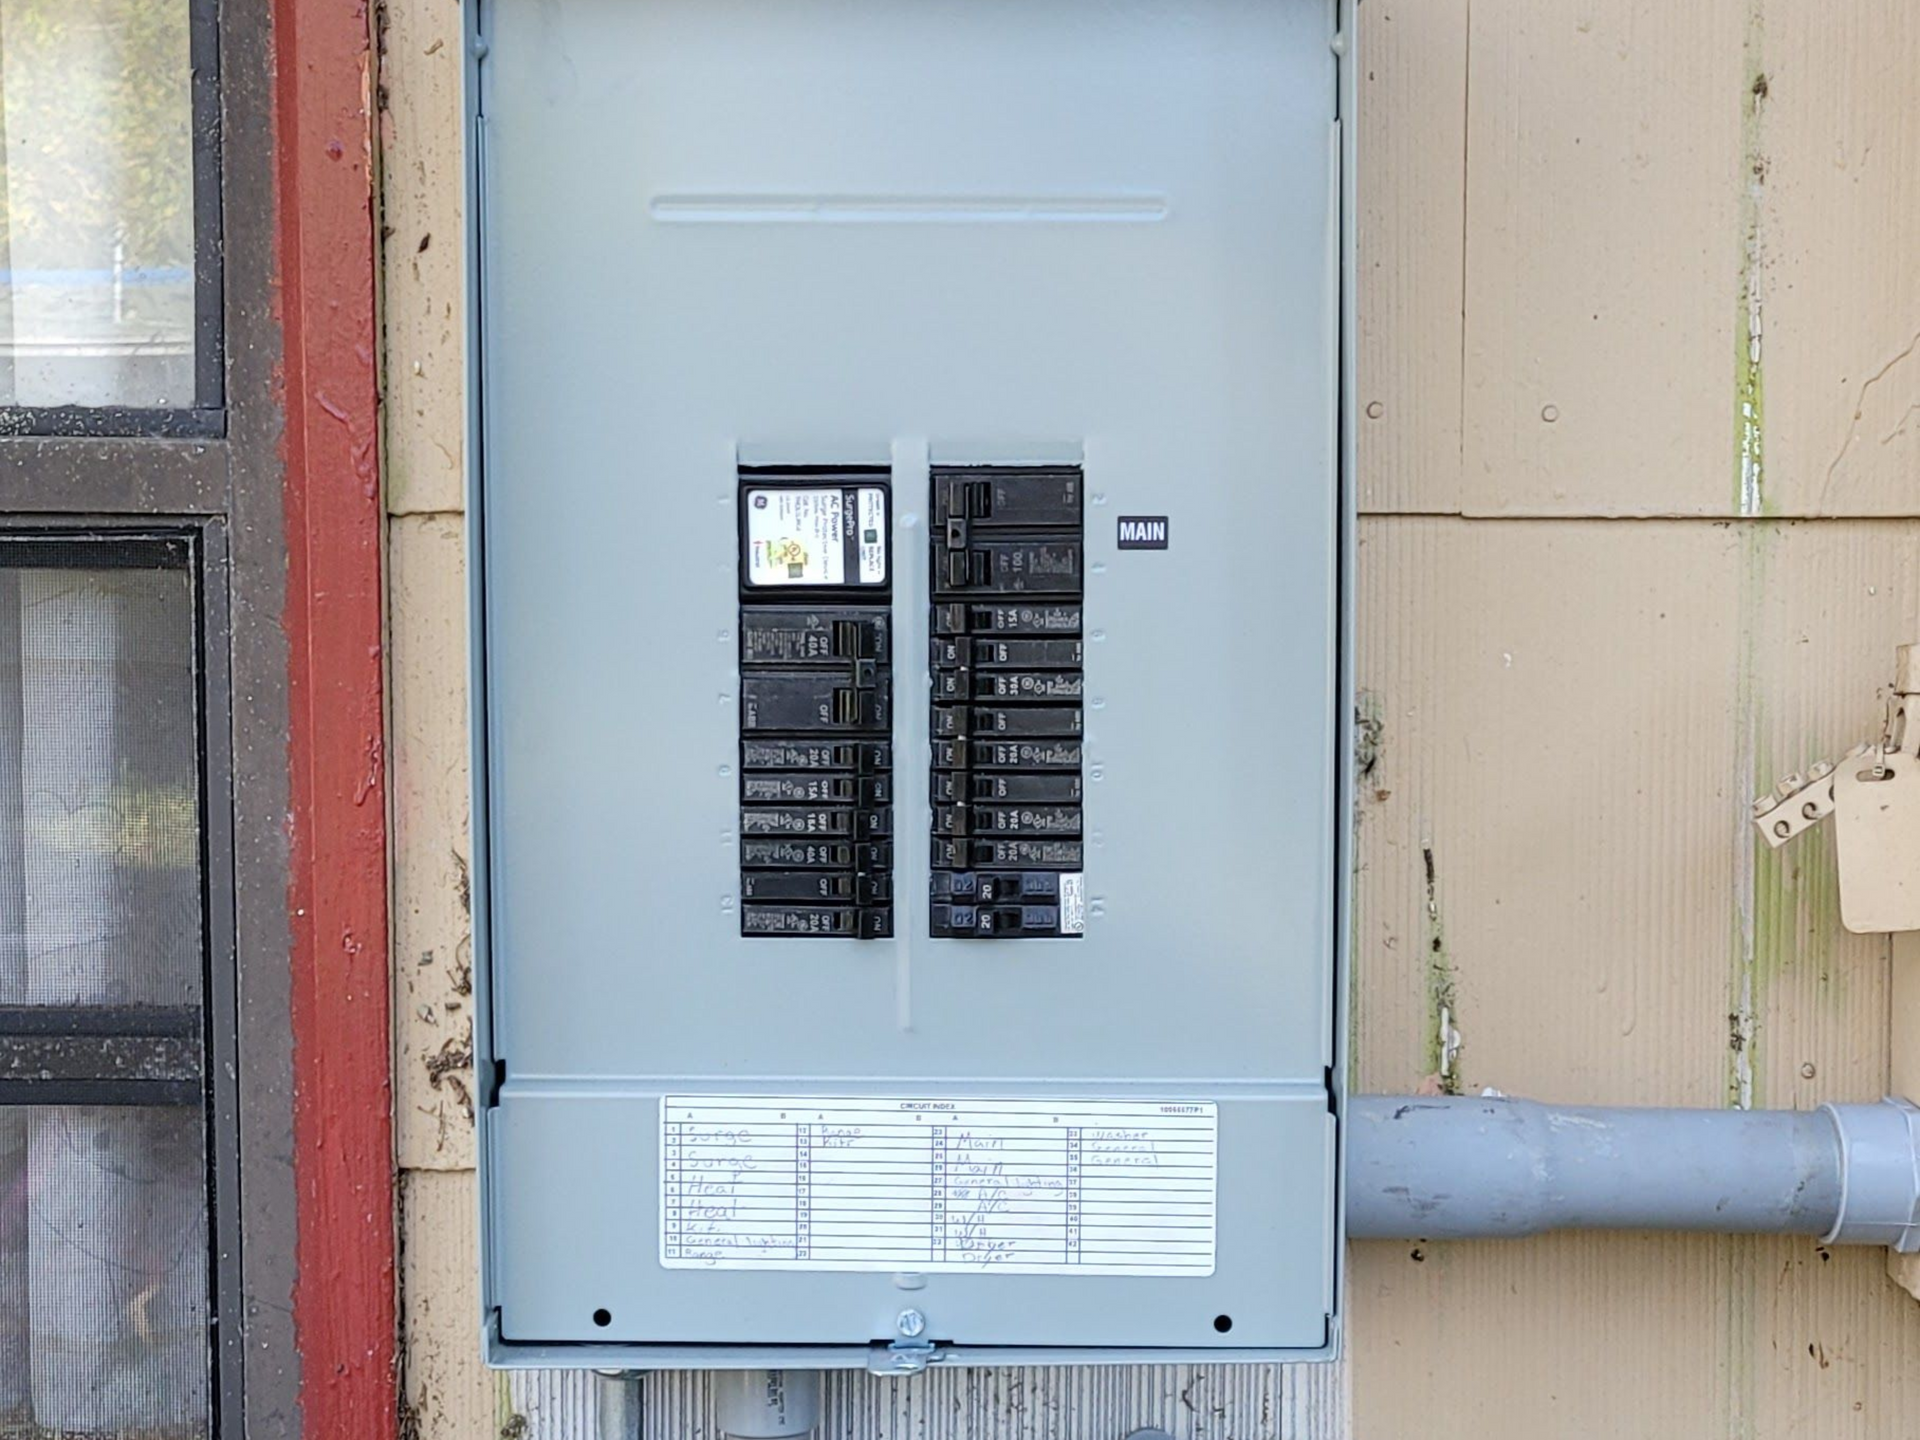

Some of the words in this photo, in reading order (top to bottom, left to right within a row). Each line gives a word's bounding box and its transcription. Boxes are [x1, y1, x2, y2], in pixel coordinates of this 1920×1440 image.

[830, 495, 840, 509] AC
[831, 512, 840, 543] Power
[1120, 522, 1164, 540] MAIN
[1008, 609, 1018, 628] 15A
[808, 635, 818, 657] 40A
[820, 637, 829, 656] OFF
[947, 645, 956, 660] ON
[998, 644, 1008, 662] OFF
[946, 677, 956, 692] ON
[998, 676, 1006, 695] OFF
[1010, 676, 1019, 696] 30A
[820, 704, 829, 723] OFF
[998, 712, 1006, 730] OFF
[809, 748, 819, 768] 20A
[821, 749, 830, 767] OFF
[946, 748, 953, 762] ON
[998, 746, 1006, 763] OFF
[1010, 744, 1018, 764] 20A
[808, 781, 818, 800] 15A
[875, 782, 882, 798] ON
[998, 778, 1007, 796] OFF
[818, 813, 827, 831] OFF
[870, 815, 878, 830] ON
[998, 811, 1006, 830] OFF
[1010, 810, 1018, 830] 20A
[807, 846, 816, 864] 40A
[819, 846, 828, 864] OFF
[998, 844, 1006, 860] OFF
[1008, 842, 1018, 861] 20A
[820, 878, 828, 896] OFF
[982, 884, 992, 900] 20
[810, 914, 820, 932] 20A
[822, 915, 830, 932] OFF
[981, 914, 990, 929] 20
[956, 1131, 1003, 1150] Main
